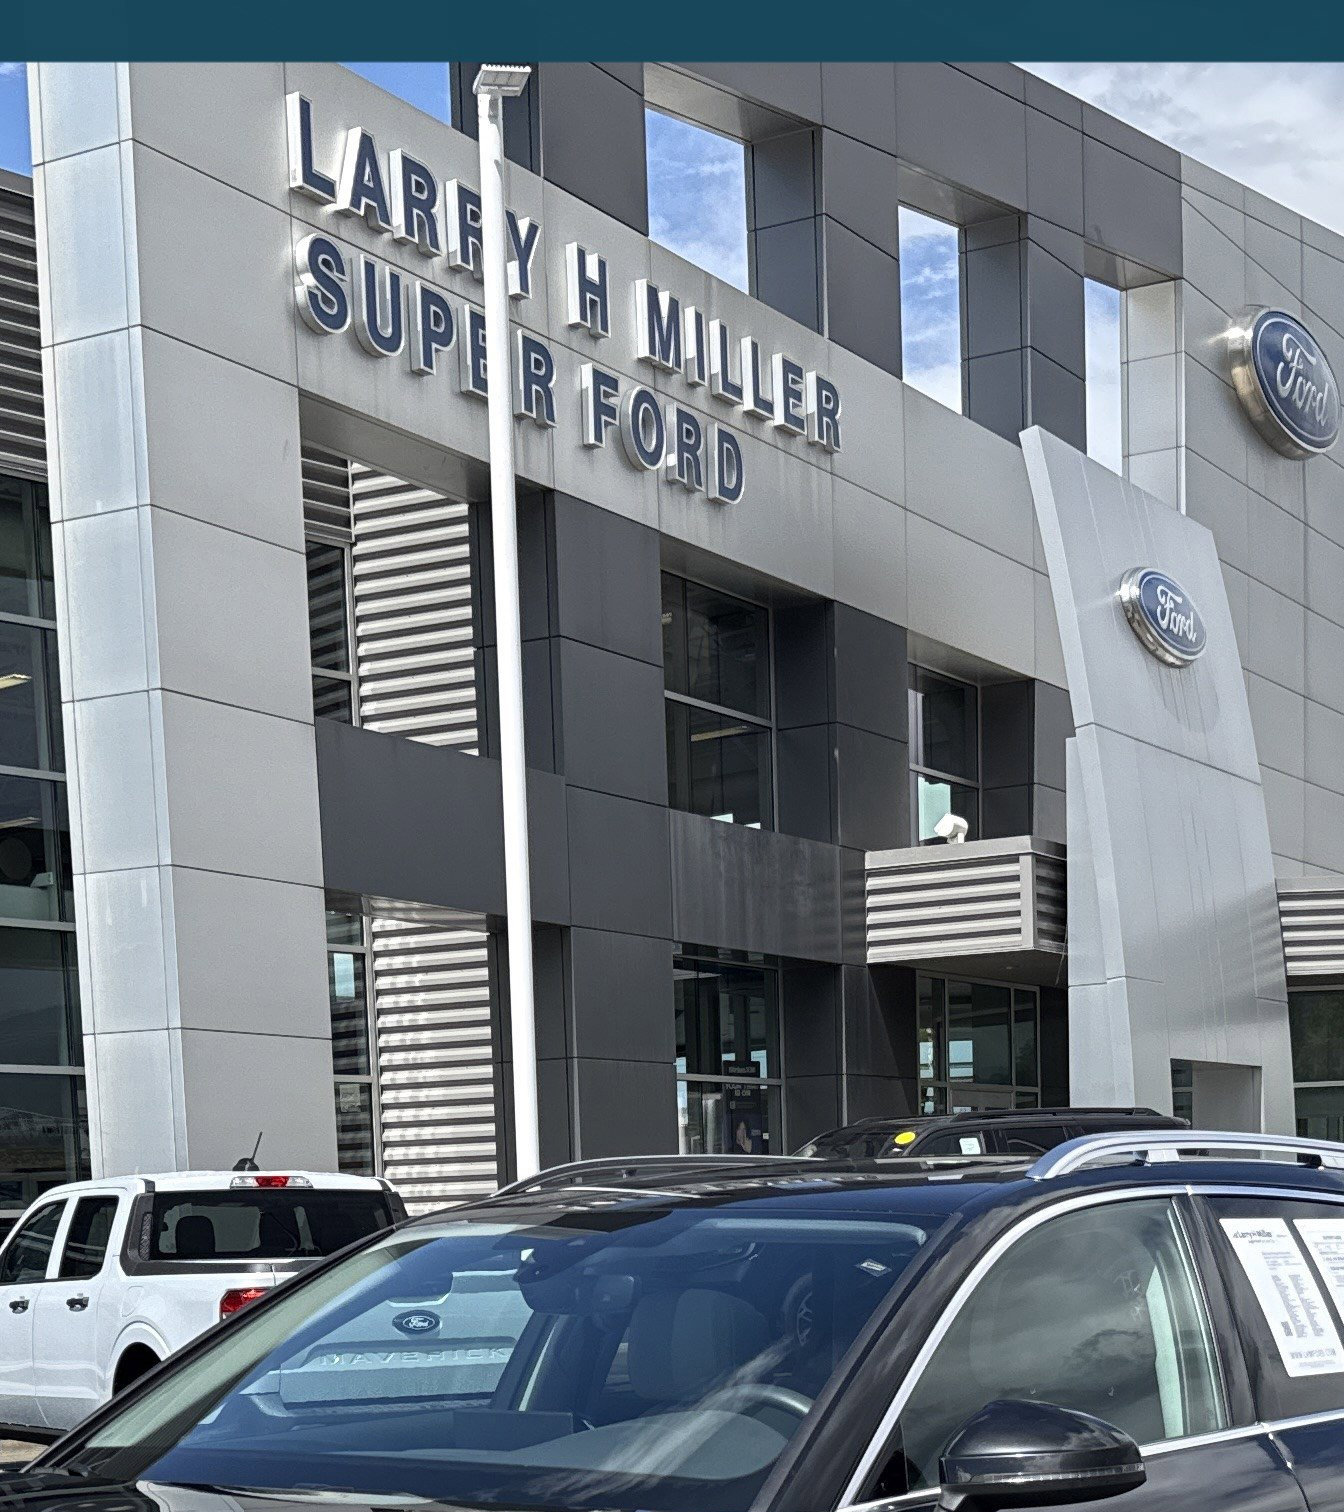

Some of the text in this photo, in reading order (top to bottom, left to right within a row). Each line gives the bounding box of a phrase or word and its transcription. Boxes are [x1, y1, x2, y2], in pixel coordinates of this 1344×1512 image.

[286, 91, 843, 453] LARRY H MILLER
[295, 232, 746, 505] SUPER FORD
[1276, 333, 1331, 427] Ford
[1156, 585, 1196, 643] Ford
[320, 1348, 511, 1367] MAVERICK
